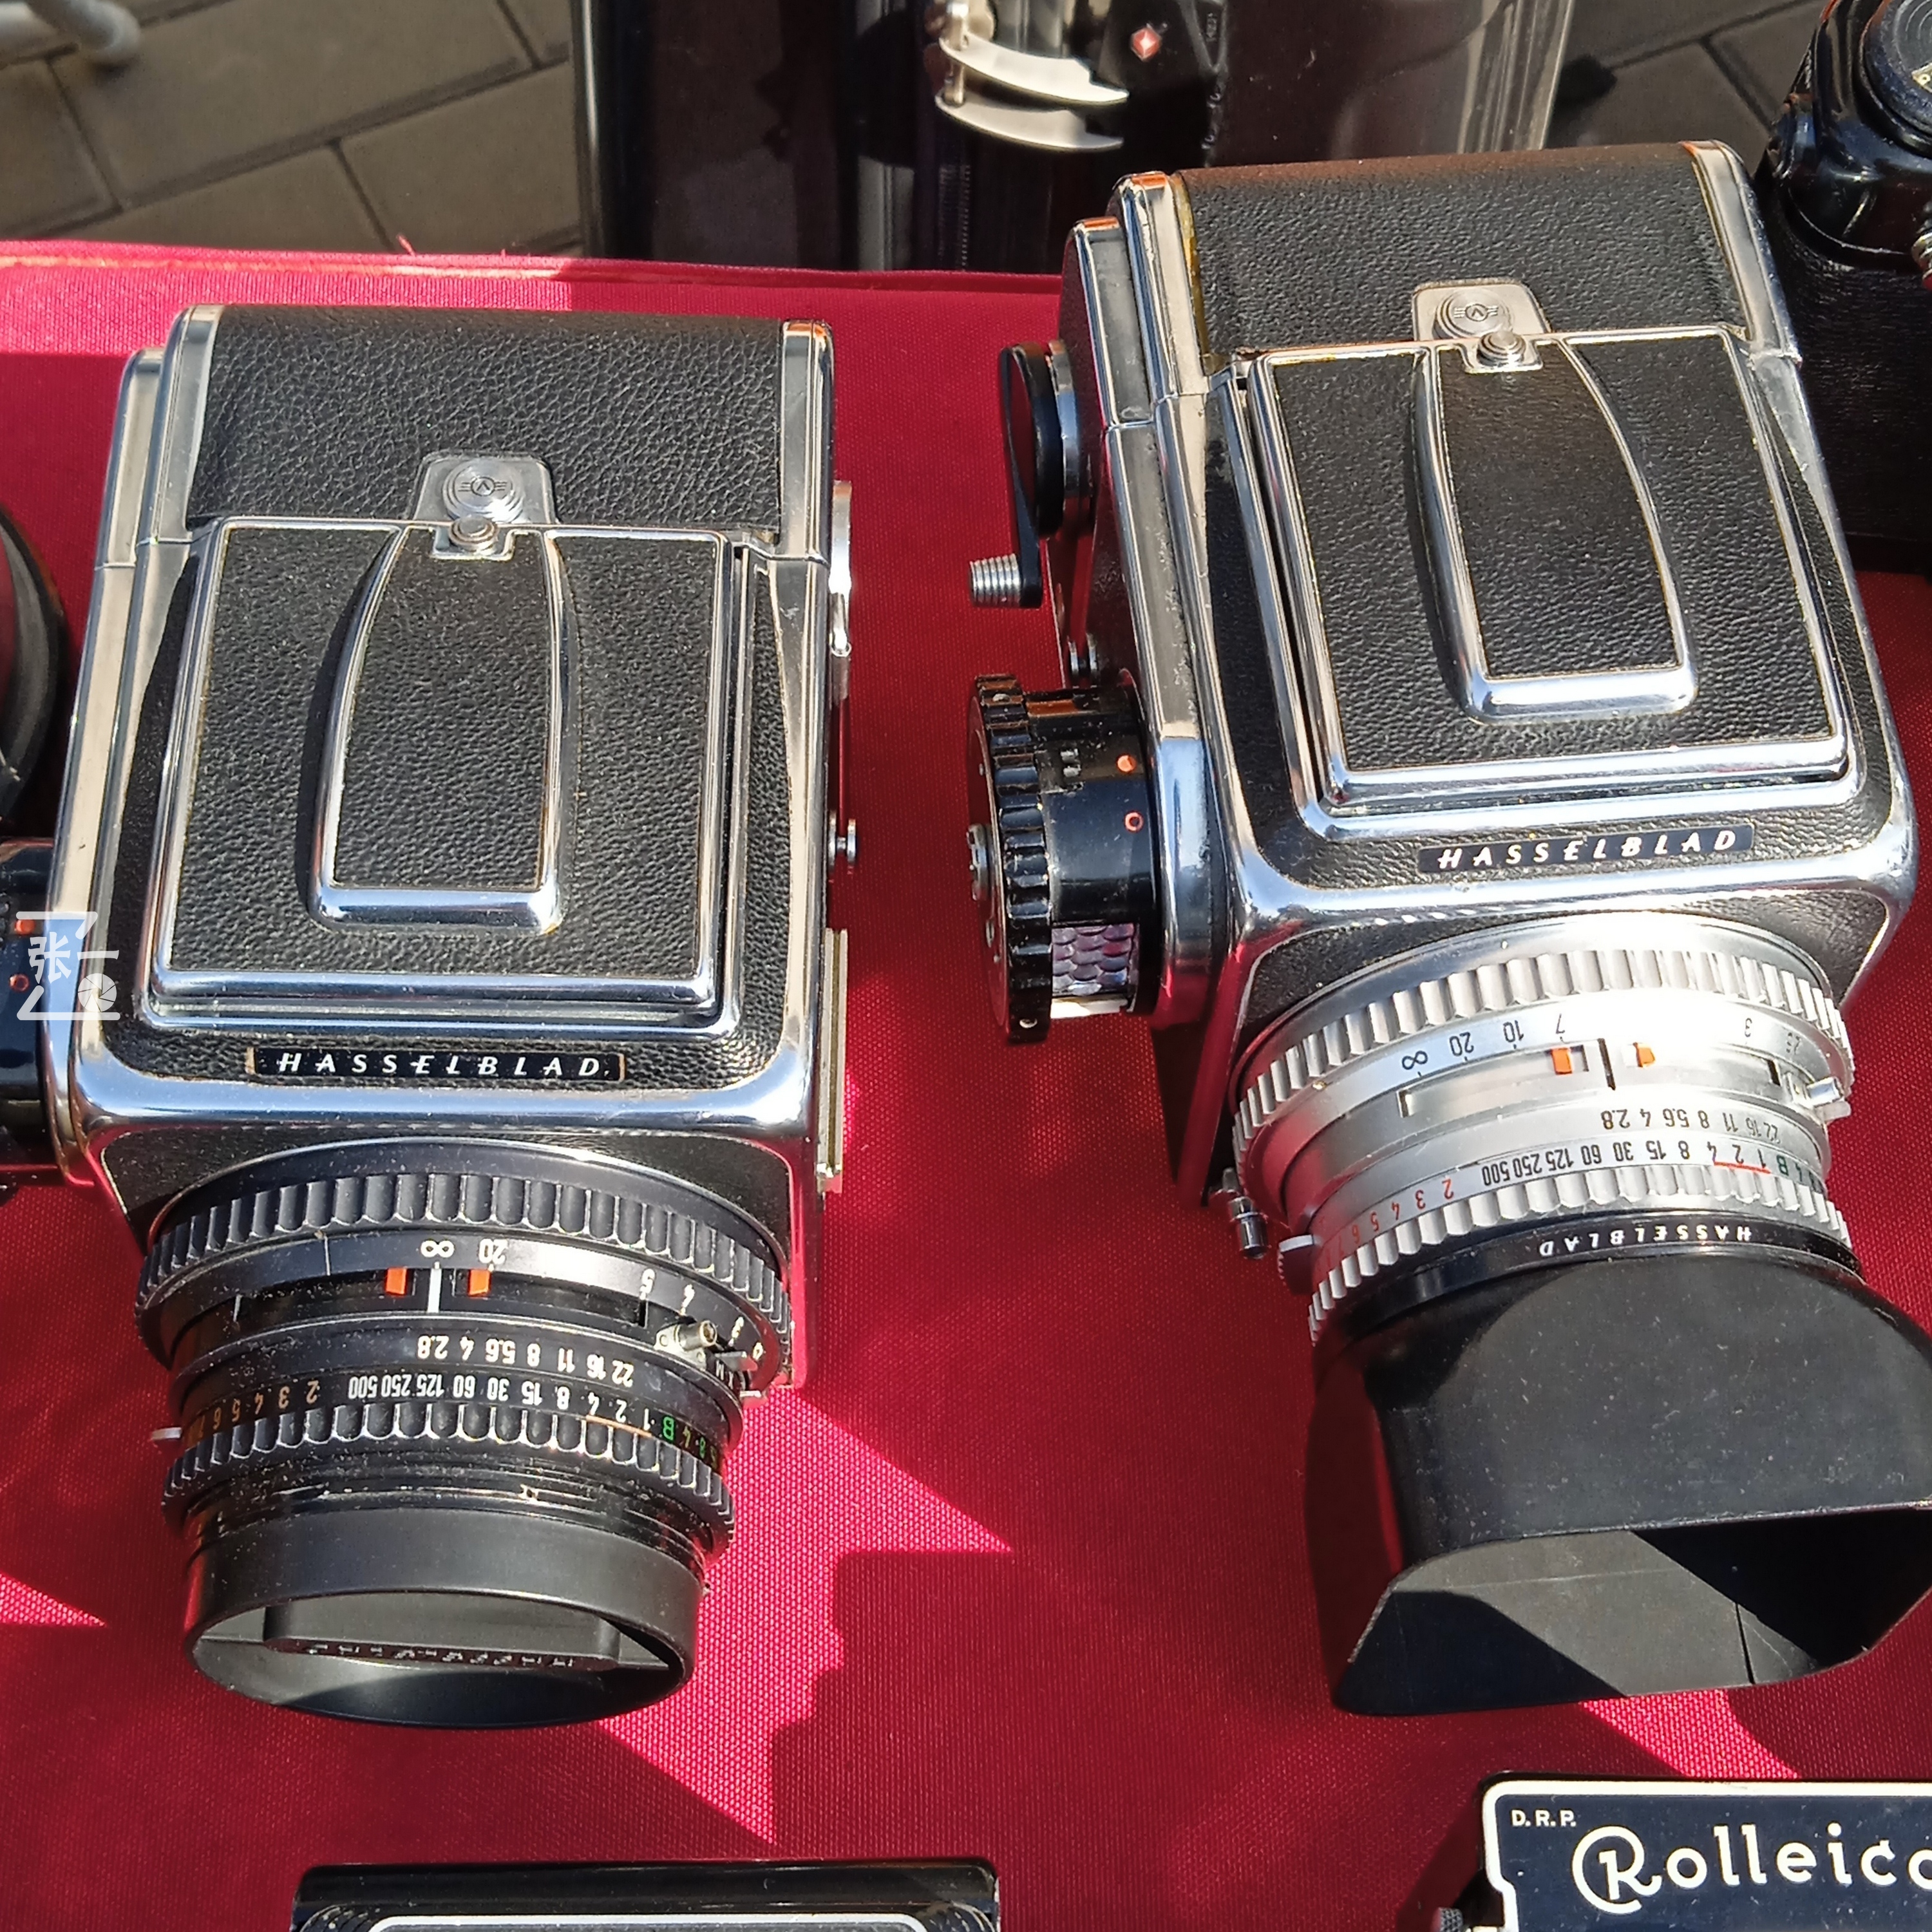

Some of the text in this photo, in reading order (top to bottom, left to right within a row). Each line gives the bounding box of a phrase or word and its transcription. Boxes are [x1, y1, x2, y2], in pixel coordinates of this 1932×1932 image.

[1438, 831, 1737, 869] HASSELBLAD
[1449, 1032, 1473, 1057] 20
[1503, 1020, 1524, 1043] 10
[276, 1052, 601, 1077] HASSELBLAD
[1640, 1108, 1651, 1127] 4
[1698, 1110, 1709, 1128] 8
[1723, 1112, 1738, 1132] 11
[1547, 1148, 1574, 1171] 125
[1581, 1144, 1602, 1165] 60
[1613, 1141, 1634, 1162] 30
[1646, 1140, 1666, 1160] 15
[1678, 1141, 1690, 1159] 8
[1707, 1141, 1717, 1161] 4
[1732, 1144, 1744, 1164] 2
[1757, 1149, 1766, 1168] 1
[1482, 1160, 1510, 1186] 500
[1514, 1153, 1542, 1178] 250
[1777, 1155, 1789, 1176] B
[1415, 1189, 1425, 1209] 3
[1442, 1178, 1454, 1199] 2
[1370, 1211, 1379, 1232] 5
[1391, 1201, 1400, 1220] 4
[478, 1238, 507, 1265] 20
[1540, 1225, 1752, 1256] HASSELBLAD
[417, 1336, 449, 1359] 2.8
[460, 1336, 475, 1361] 4
[527, 1343, 541, 1367] 8
[558, 1347, 575, 1373] 11
[587, 1354, 606, 1379] 16
[612, 1360, 634, 1387] 22
[306, 1379, 321, 1404] 2
[348, 1376, 377, 1399] 500
[381, 1374, 412, 1397] 250
[416, 1374, 444, 1397] 125
[453, 1375, 475, 1399] 60
[487, 1377, 509, 1401] 30
[521, 1381, 542, 1406] 15
[254, 1392, 264, 1415] 4
[278, 1386, 290, 1409] 3
[557, 1386, 570, 1410] 8
[587, 1392, 600, 1416] 4
[213, 1408, 222, 1430] 6
[231, 1399, 242, 1422] 5
[616, 1399, 628, 1423] 2
[643, 1408, 651, 1431] 1
[663, 1417, 675, 1441] B
[1511, 1810, 1577, 1827] D.R.P.
